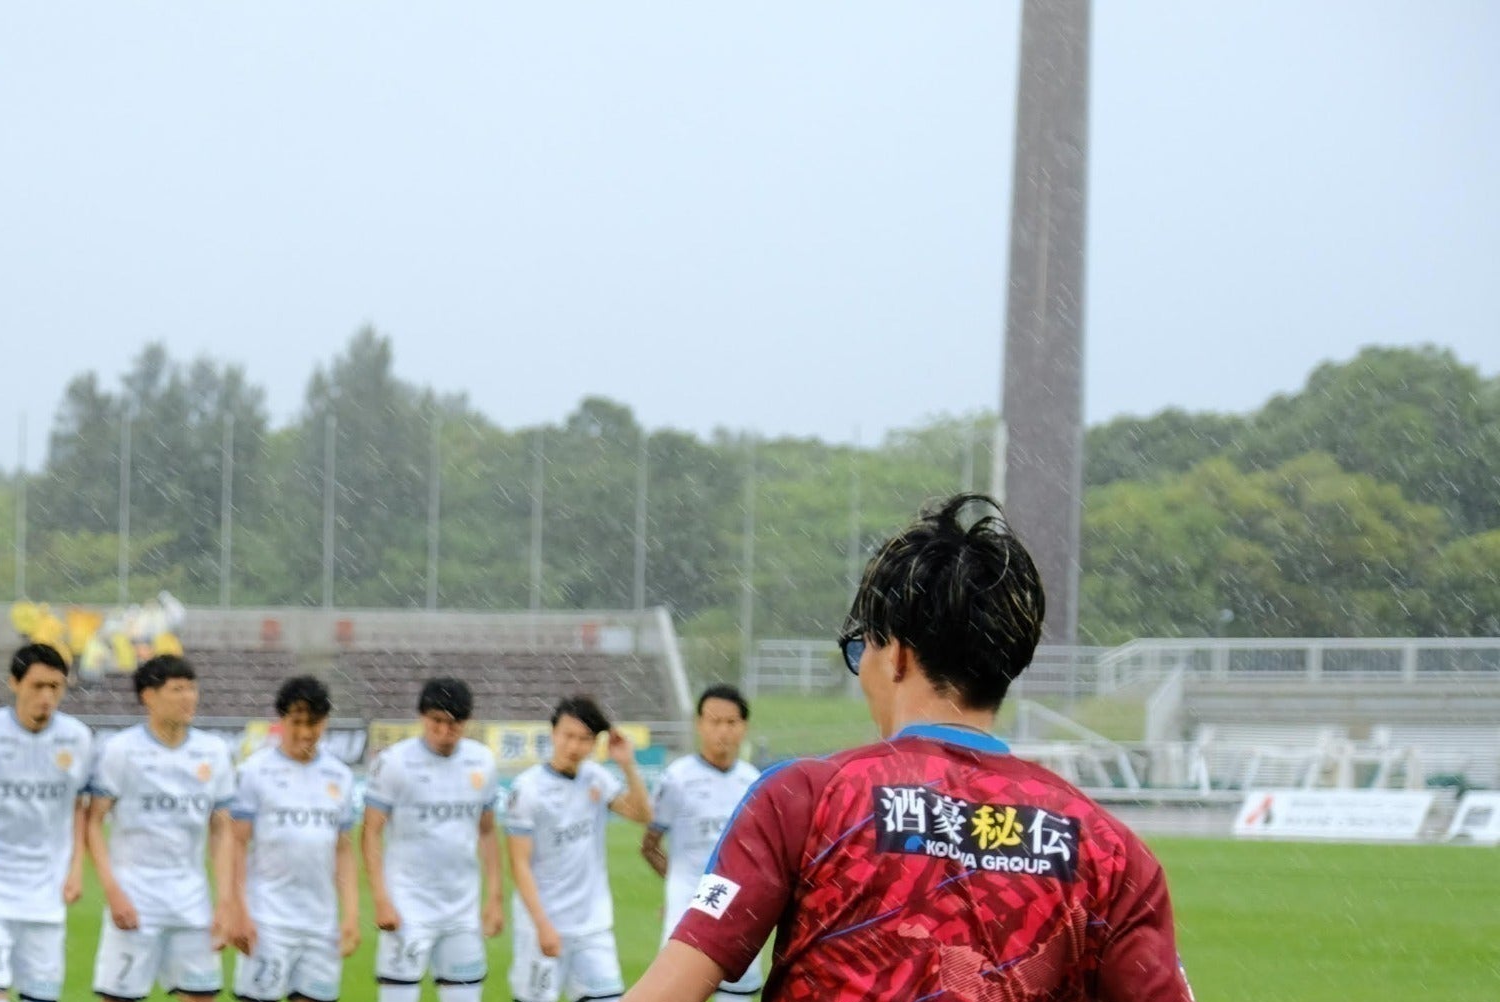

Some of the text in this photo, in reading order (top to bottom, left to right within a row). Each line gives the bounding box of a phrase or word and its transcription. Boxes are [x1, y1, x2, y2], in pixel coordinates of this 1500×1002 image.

[879, 786, 1073, 862] 酒豪秘伝
[980, 854, 1052, 875] GROUP
